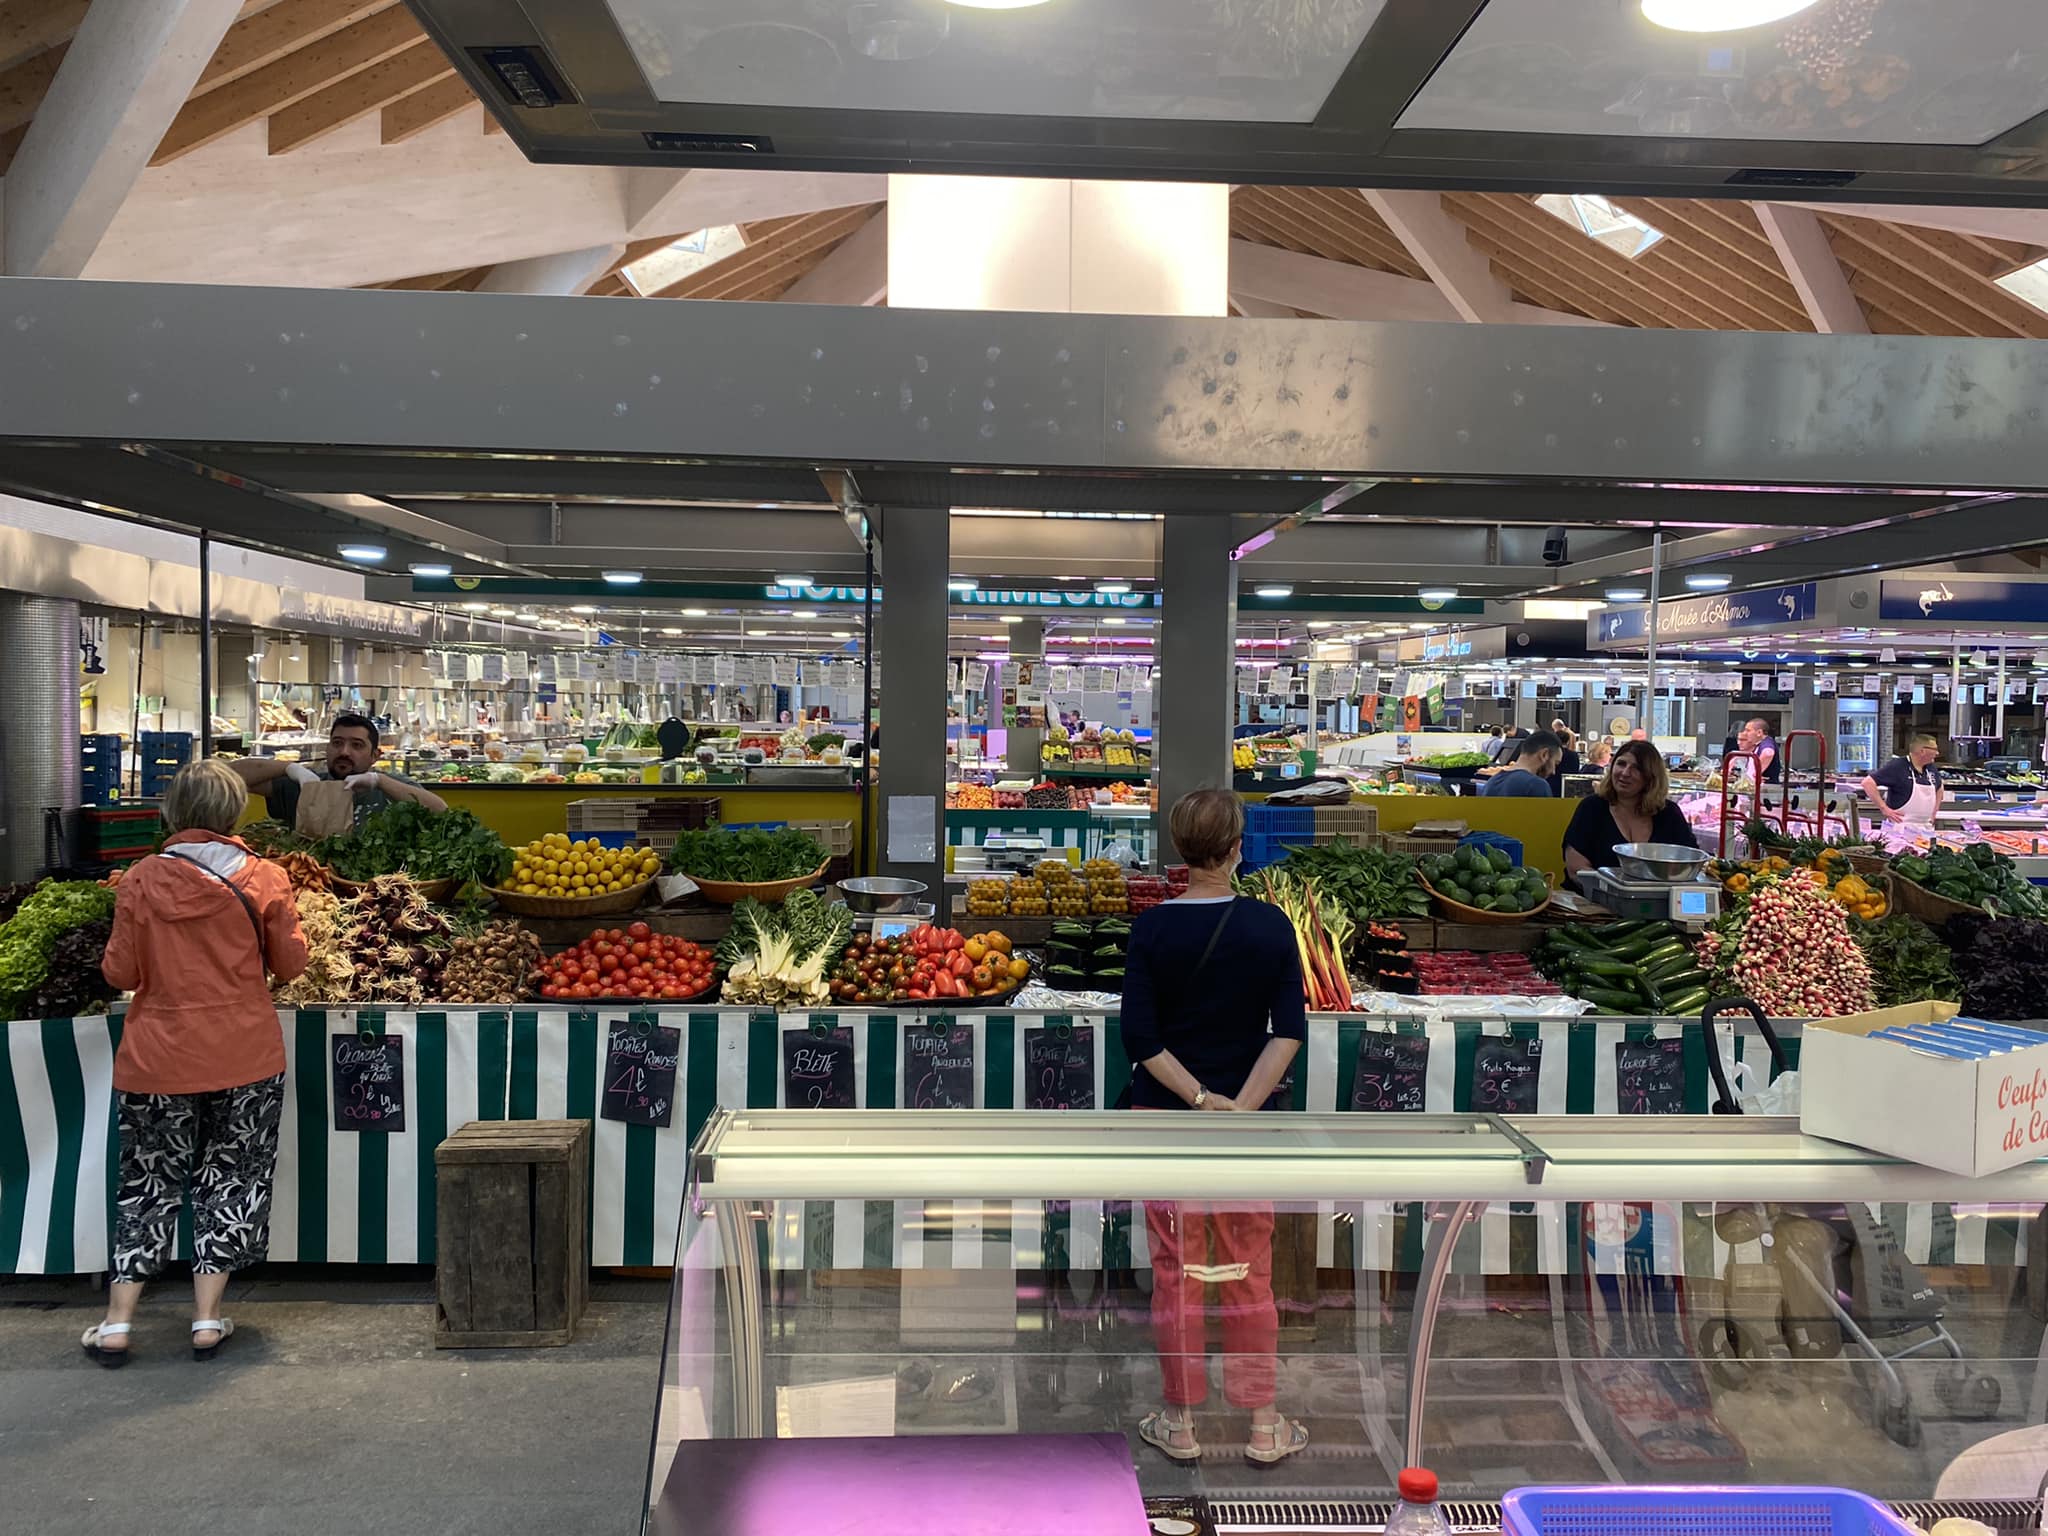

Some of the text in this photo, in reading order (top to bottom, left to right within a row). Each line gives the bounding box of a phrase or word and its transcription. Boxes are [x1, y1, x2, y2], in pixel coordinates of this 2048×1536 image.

[1662, 605, 1699, 632] Marée
[1700, 598, 1750, 624] d'Armor
[1504, 1061, 1531, 1077] Rouges
[1998, 1067, 2048, 1112] Oeufs
[2003, 1117, 2023, 1152] de
